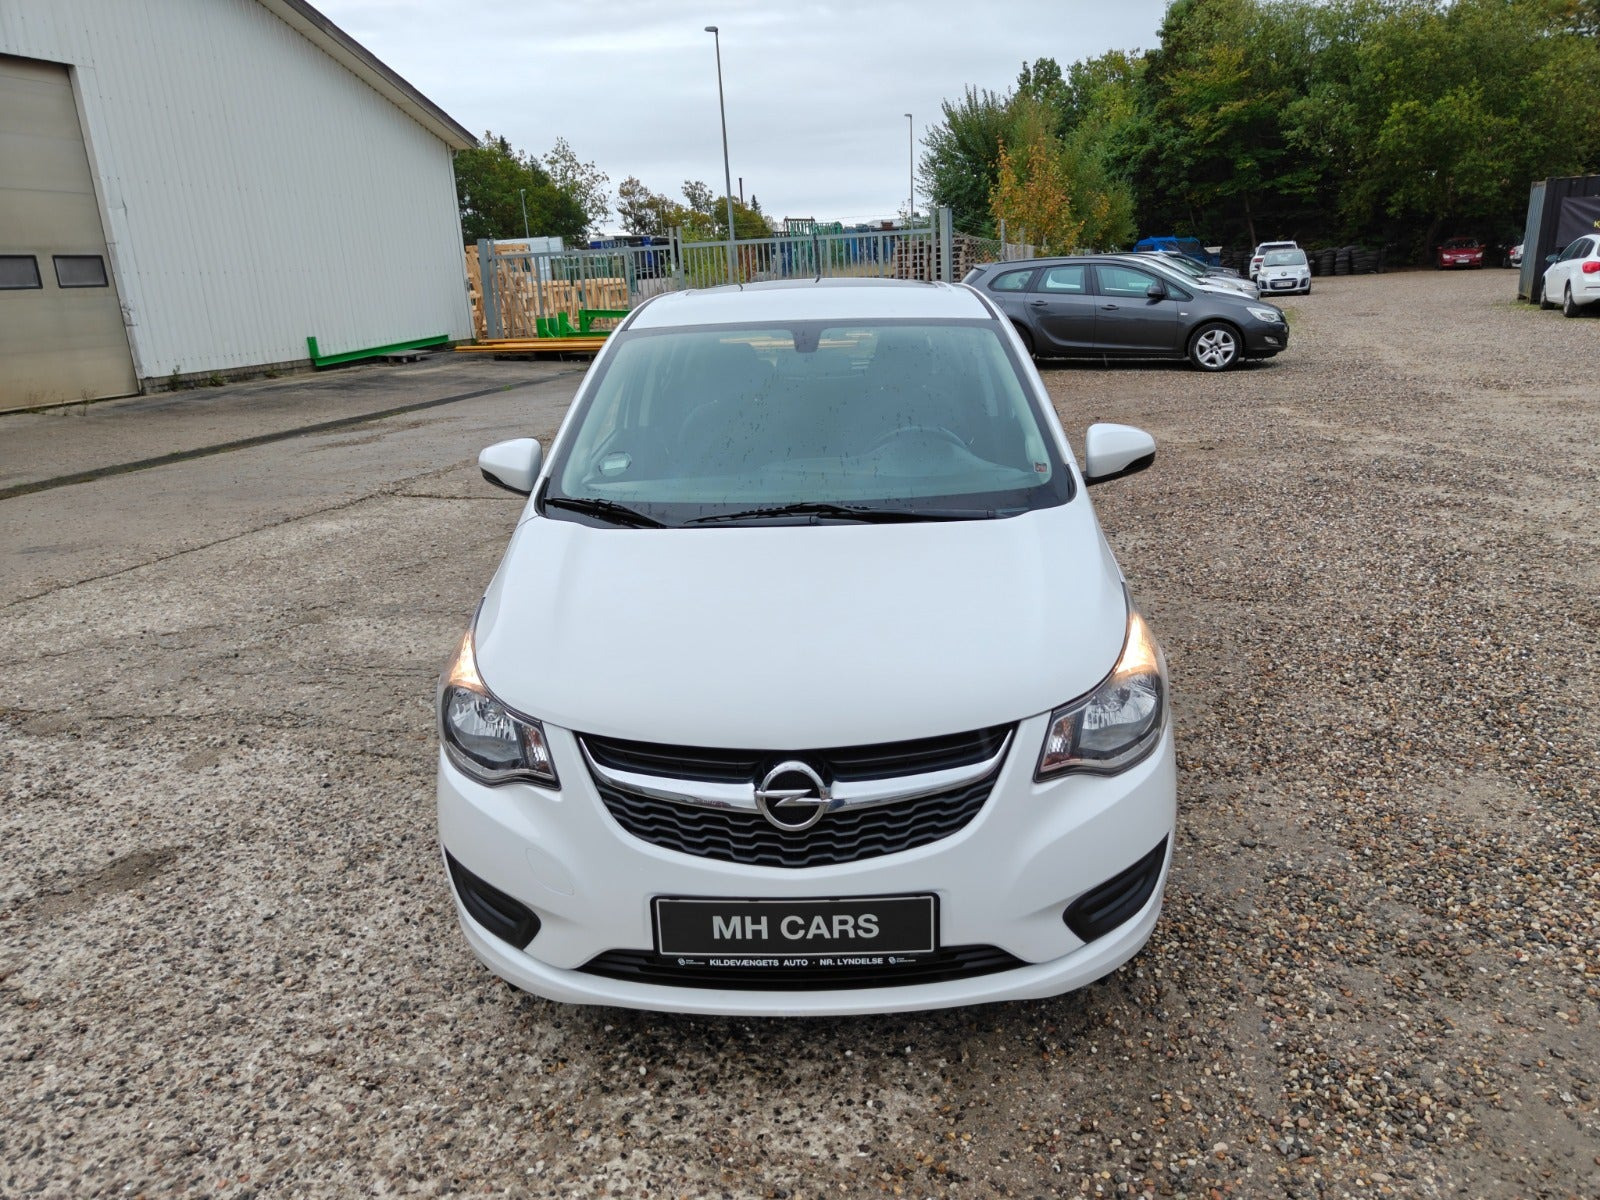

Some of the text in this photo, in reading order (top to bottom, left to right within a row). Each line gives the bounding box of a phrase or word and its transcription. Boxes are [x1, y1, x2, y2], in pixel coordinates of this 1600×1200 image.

[712, 913, 880, 940] MH CARS
[709, 958, 780, 967] KILDEVÆNGETS
[783, 958, 809, 967] AUTO
[819, 958, 836, 966] NR.
[837, 957, 884, 966] LYNDELSE
